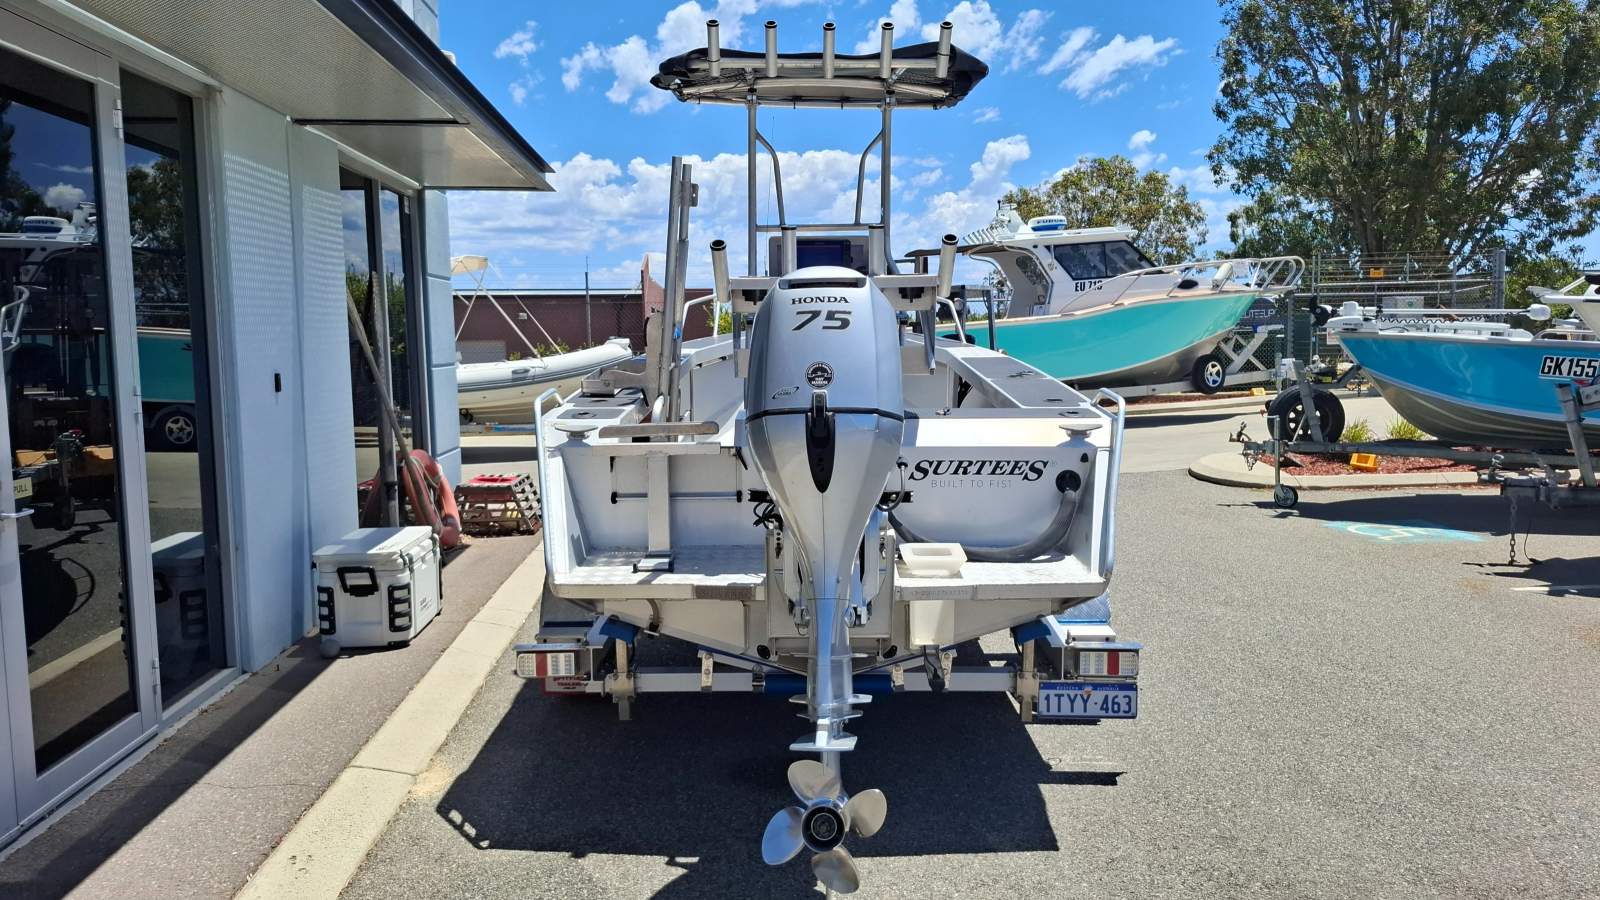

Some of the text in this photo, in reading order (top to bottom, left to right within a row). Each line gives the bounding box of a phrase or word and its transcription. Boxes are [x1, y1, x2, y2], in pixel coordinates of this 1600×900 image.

[1074, 281, 1086, 292] EU
[791, 296, 850, 305] HONDA
[792, 310, 852, 331] 75
[908, 459, 1049, 481] SURTEES
[931, 479, 964, 488] BUILT
[970, 479, 984, 488] TO
